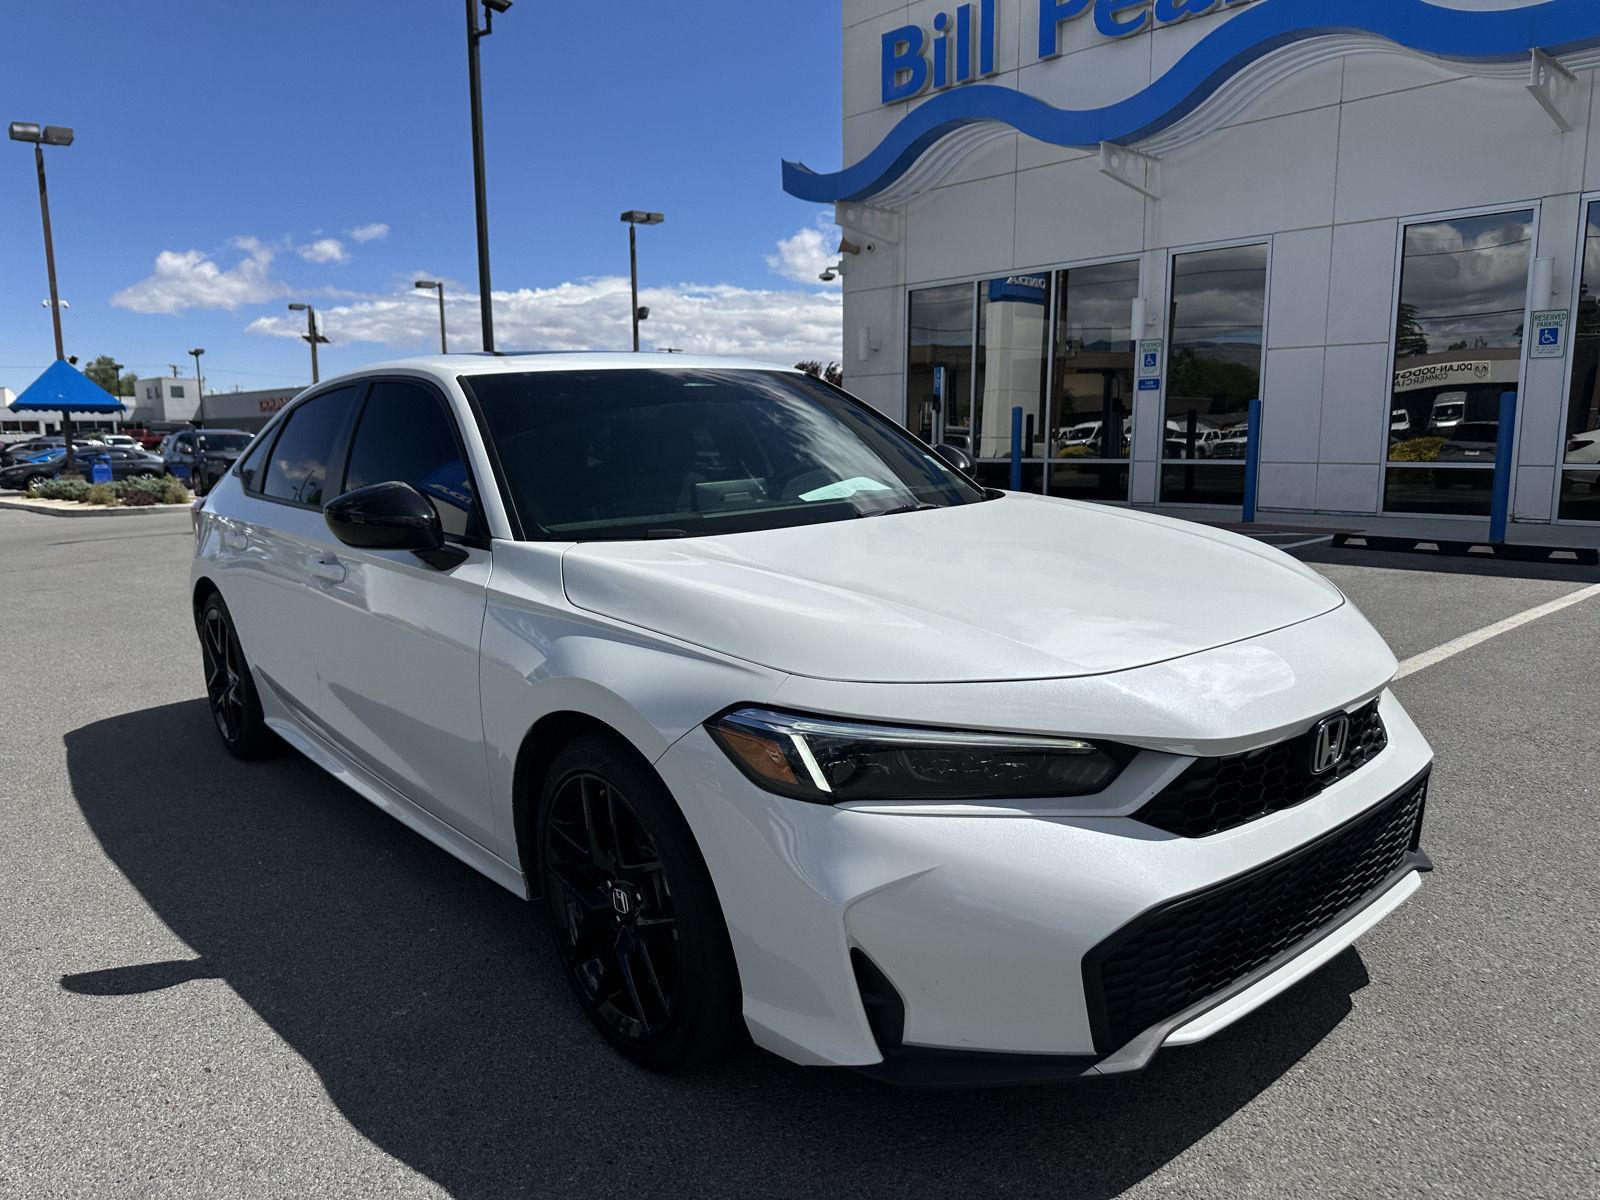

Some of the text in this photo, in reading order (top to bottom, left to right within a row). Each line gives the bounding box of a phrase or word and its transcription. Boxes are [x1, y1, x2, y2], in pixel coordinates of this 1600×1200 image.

[881, 0, 1240, 105] Bill Pea
[1534, 313, 1567, 322] RESERVED
[1536, 320, 1563, 328] PARKING
